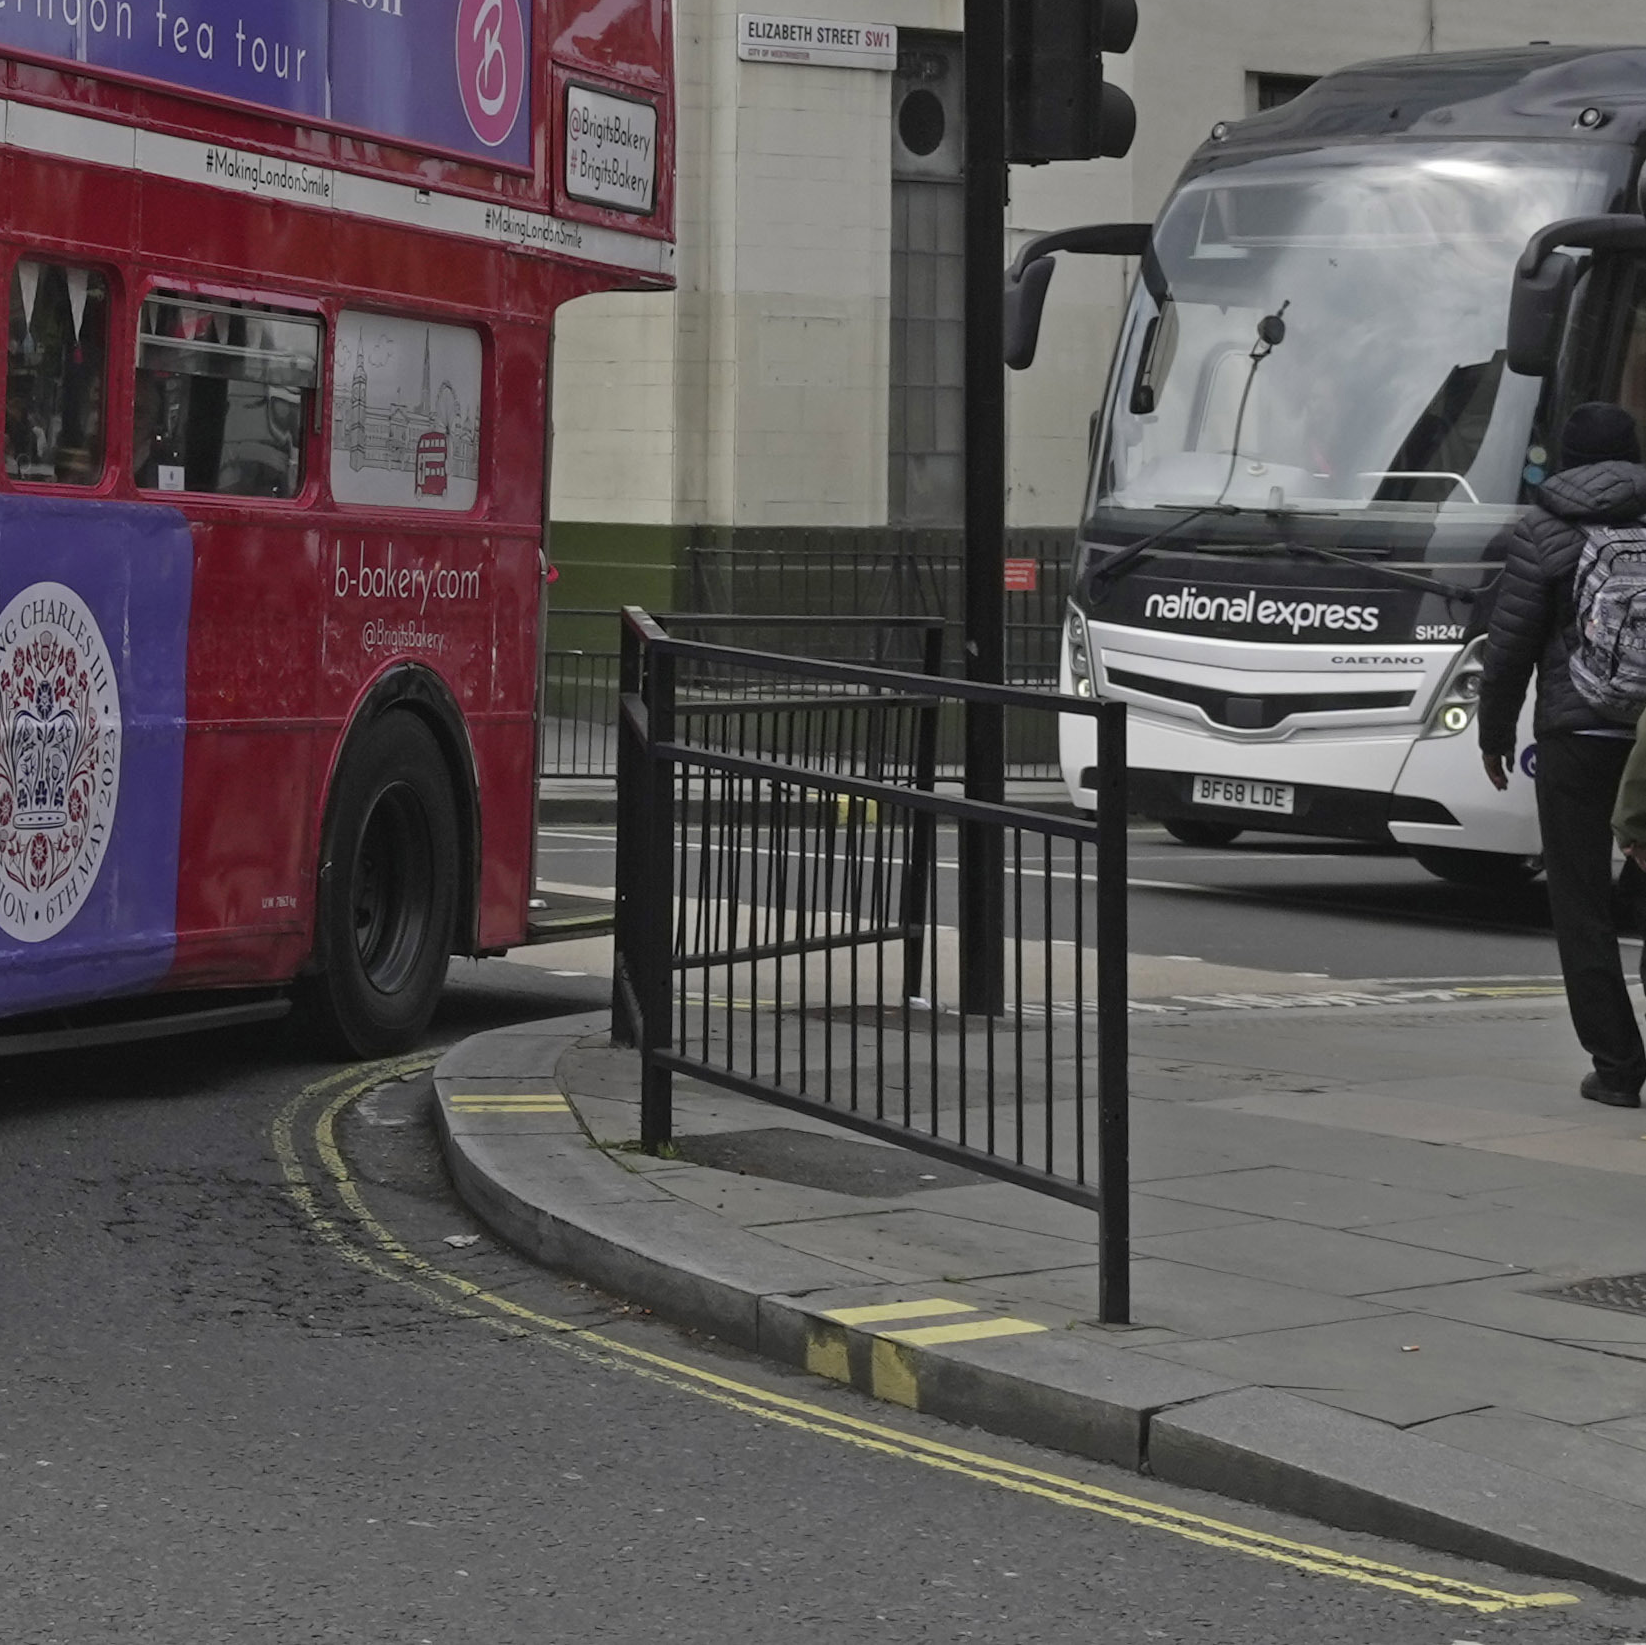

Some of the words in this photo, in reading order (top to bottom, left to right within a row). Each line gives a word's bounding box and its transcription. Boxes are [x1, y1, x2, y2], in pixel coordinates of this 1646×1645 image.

[235, 18, 308, 83] tour
[748, 22, 812, 42] ELIZABETH
[817, 27, 861, 46] STREET
[865, 31, 890, 48] SW1
[569, 107, 651, 161] @BrigitsBakery
[206, 148, 330, 198] #MakingLondonSmile
[580, 149, 649, 202] BrigitsBakery
[485, 208, 582, 249] #MakingLondonSmile
[335, 539, 481, 616] b-bakery.com
[1144, 586, 1256, 623] national
[1257, 599, 1379, 635] express
[1415, 625, 1466, 641] SH247
[20, 598, 94, 658] CHARLES
[90, 654, 108, 694] III
[362, 618, 444, 654] @BrigitsBakery
[1331, 656, 1425, 665] CAETANO
[1200, 782, 1246, 804] BF68
[1250, 786, 1287, 808] LDE
[46, 877, 79, 924] 6TH
[77, 813, 105, 882] MAY
[99, 728, 117, 809] 2023
